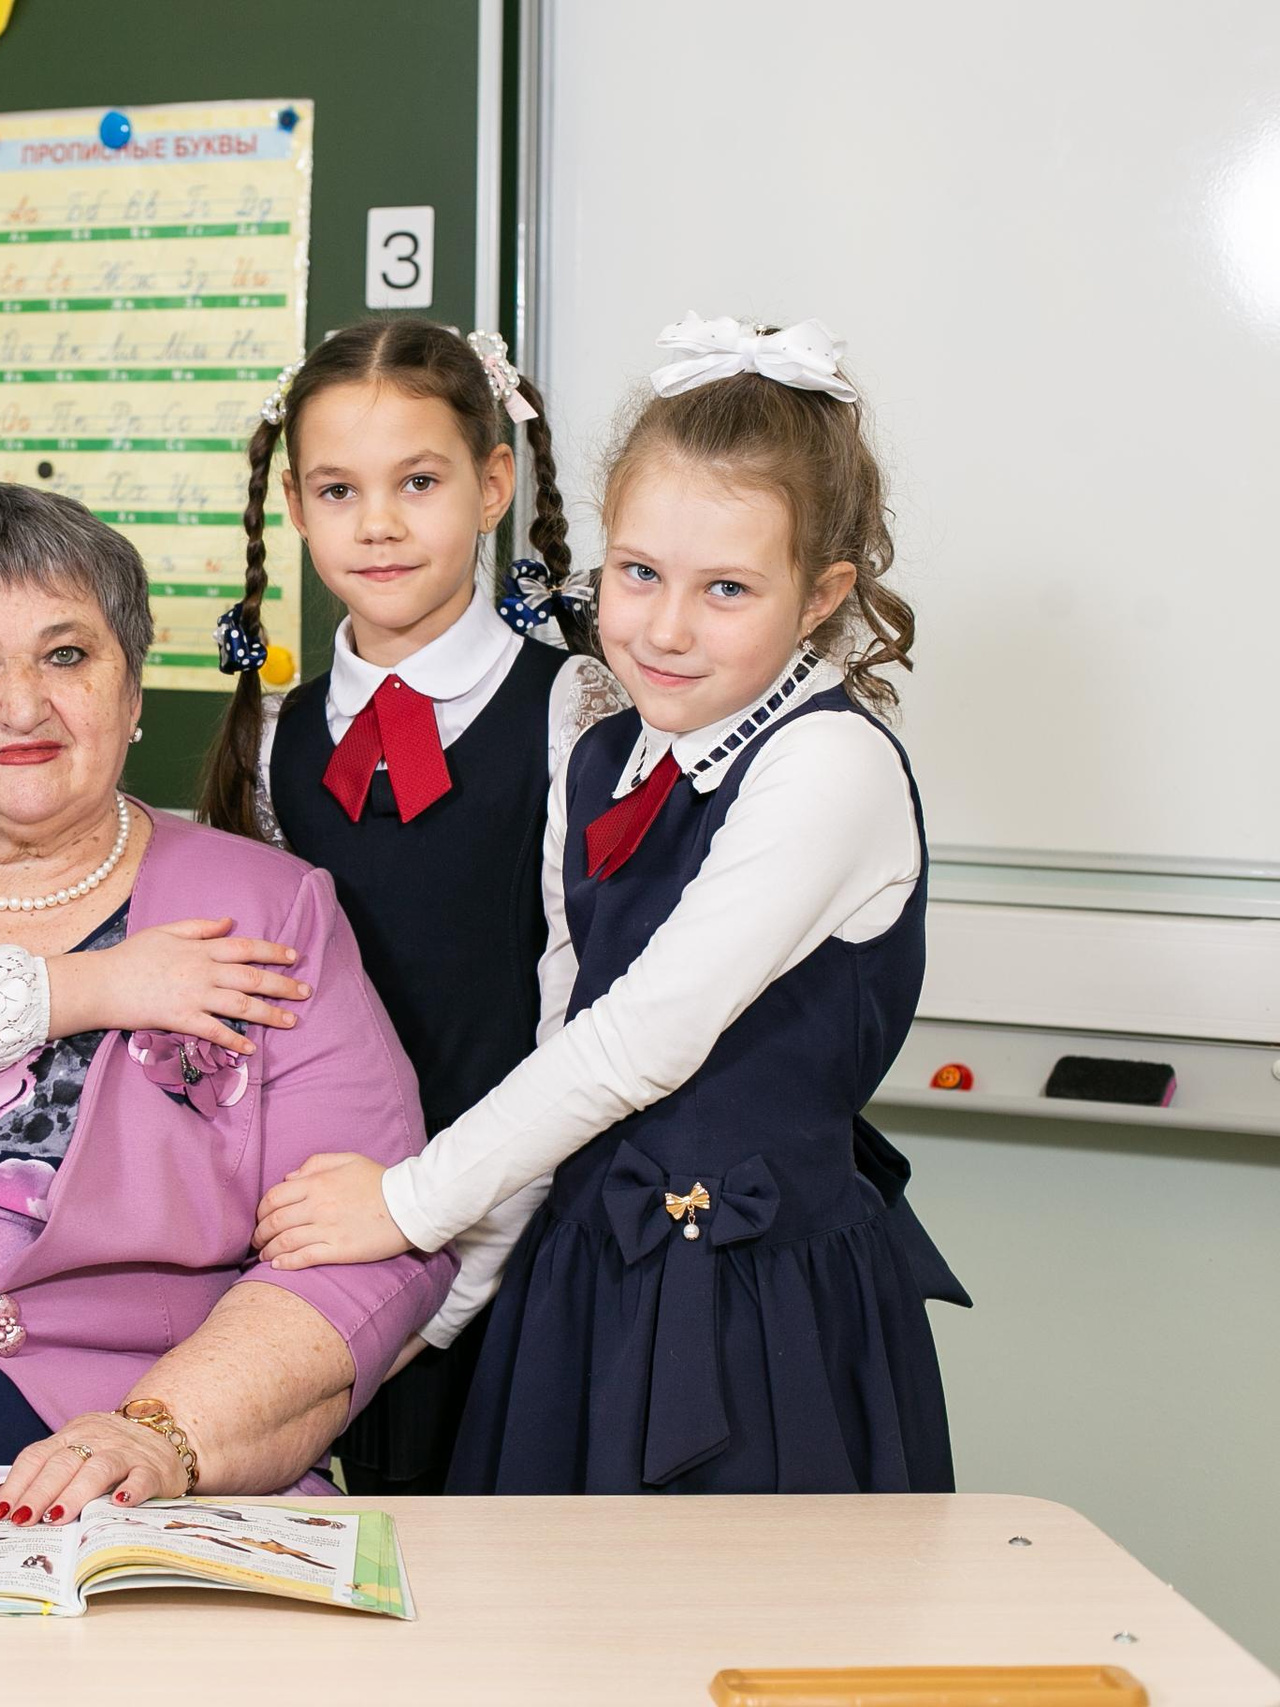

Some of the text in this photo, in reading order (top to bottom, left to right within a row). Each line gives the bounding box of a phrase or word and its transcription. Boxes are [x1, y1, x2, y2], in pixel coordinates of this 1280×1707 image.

[21, 134, 259, 165] ПРОПИСНЫЕ БУКВЫ
[381, 231, 420, 290] 3
